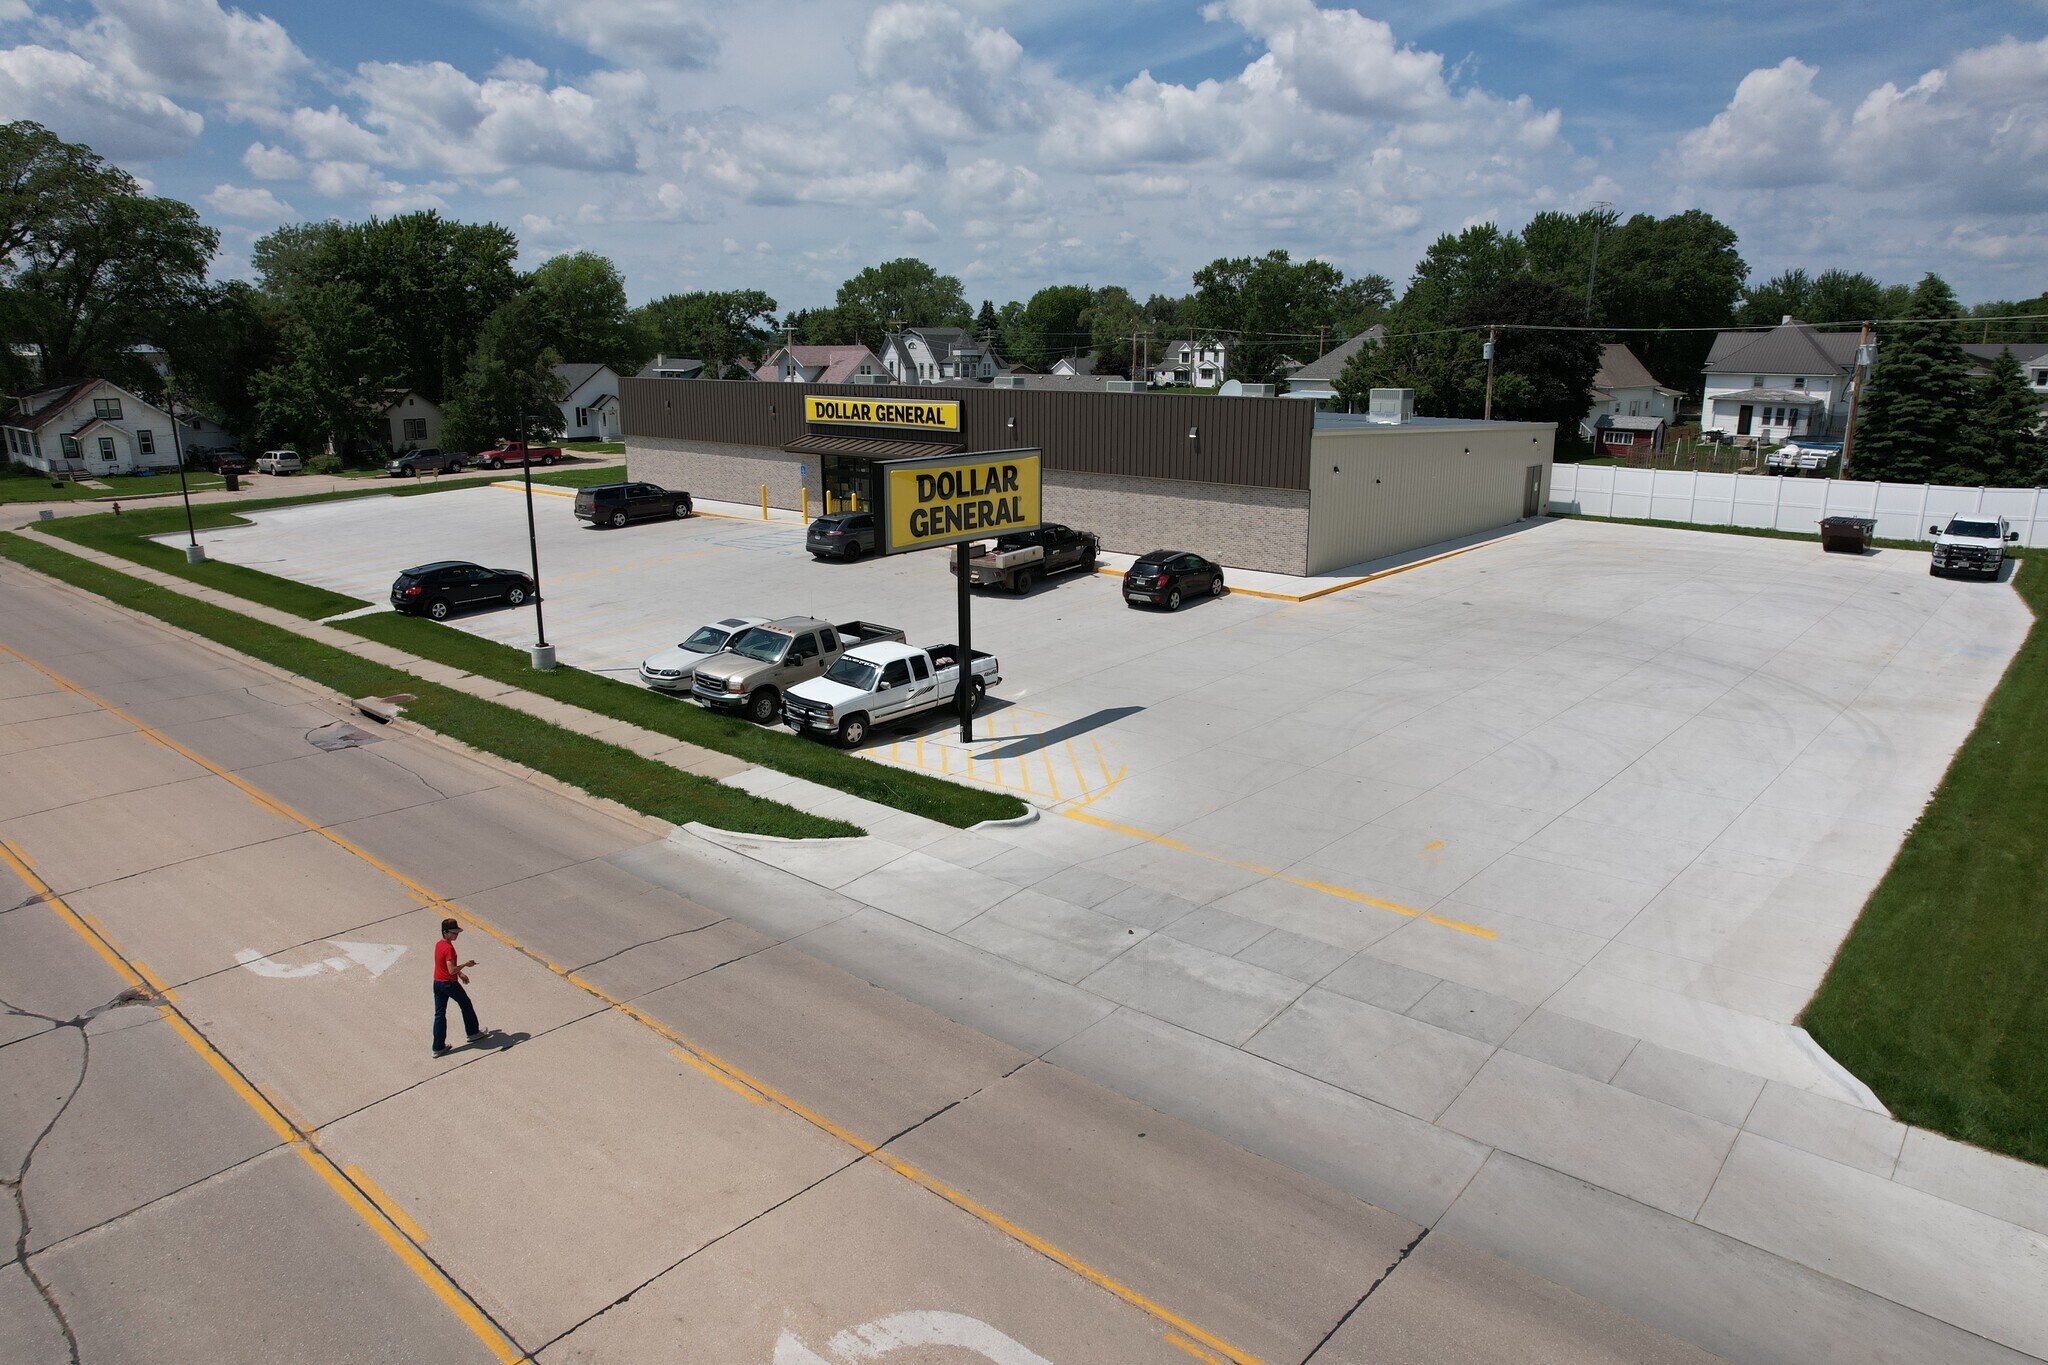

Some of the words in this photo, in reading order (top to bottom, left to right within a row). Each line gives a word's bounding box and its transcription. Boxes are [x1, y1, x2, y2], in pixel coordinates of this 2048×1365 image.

[815, 402, 871, 421] DOLLAR
[876, 405, 945, 425] GENERAL
[916, 465, 1018, 503] DOLLAR
[910, 496, 1025, 538] GENERAL
